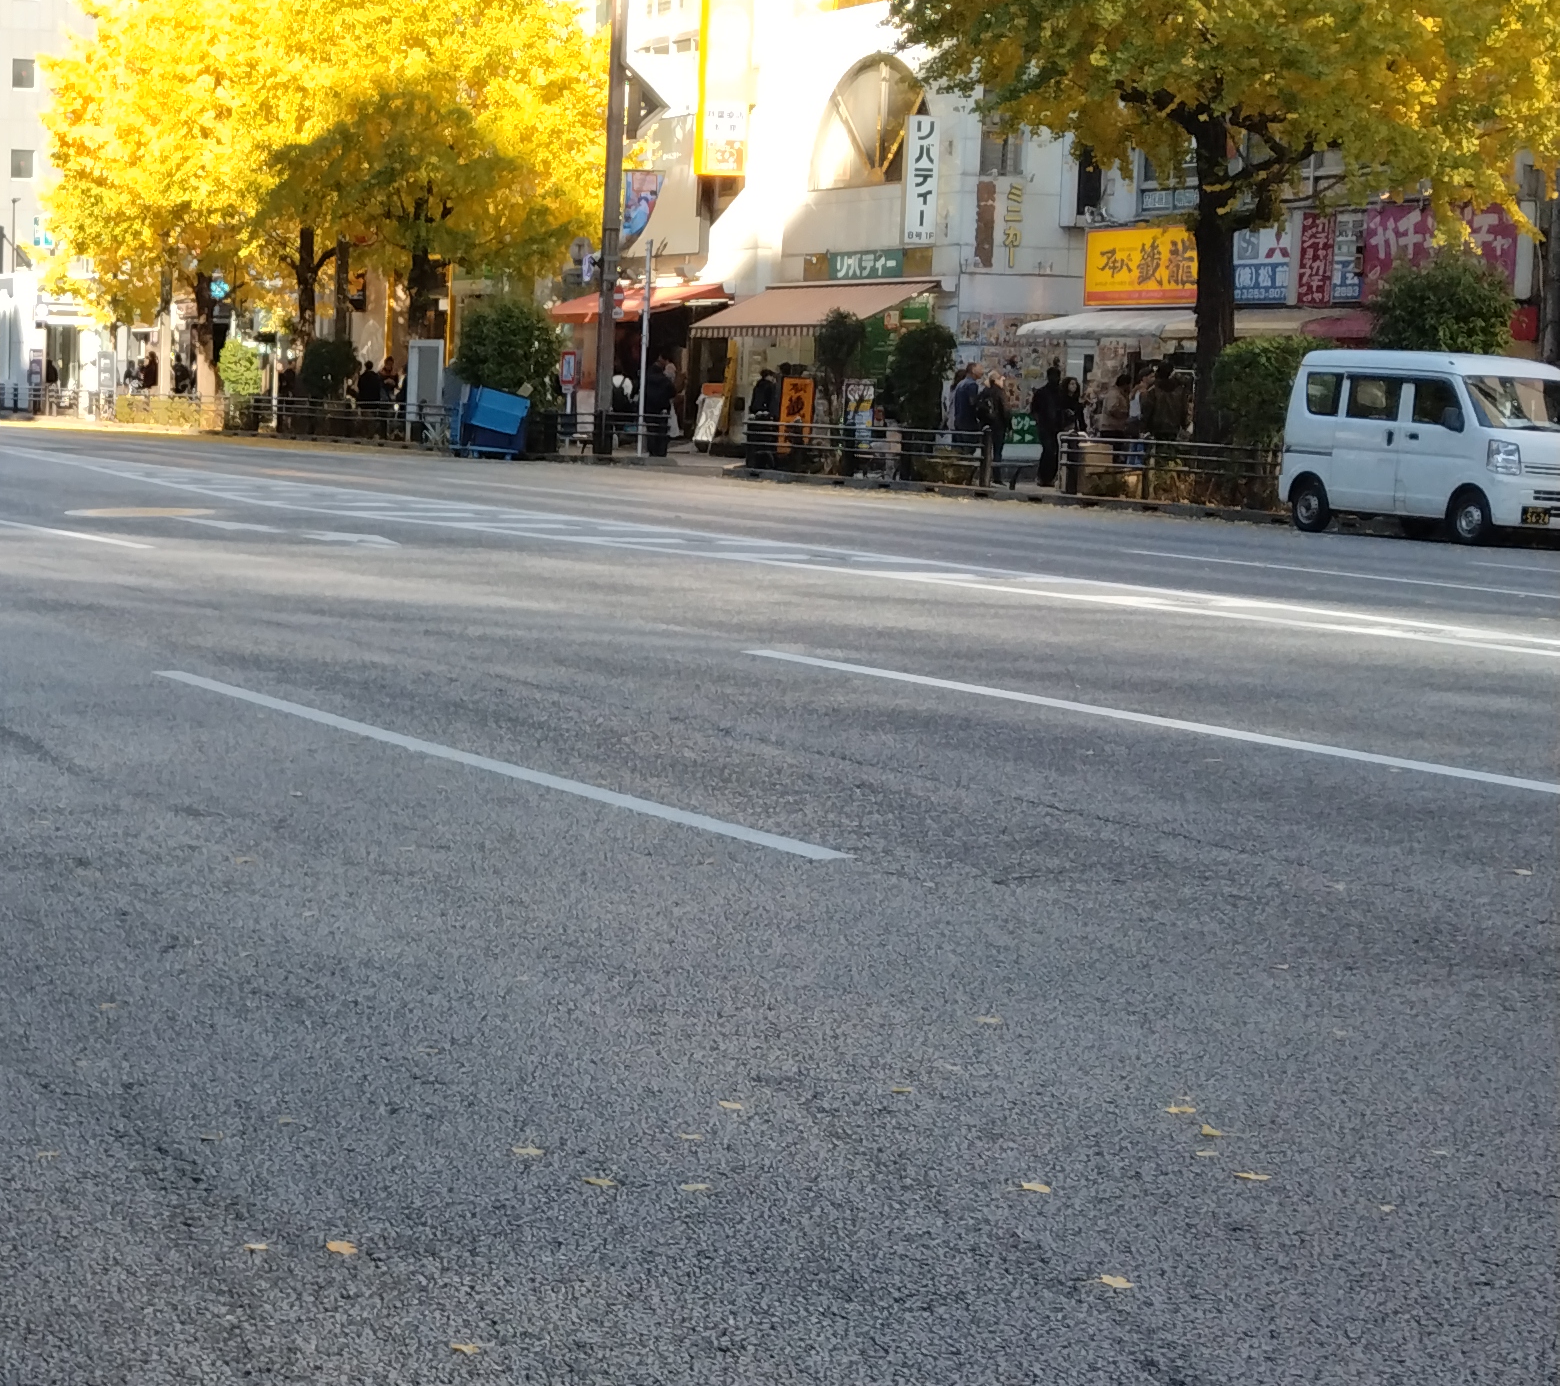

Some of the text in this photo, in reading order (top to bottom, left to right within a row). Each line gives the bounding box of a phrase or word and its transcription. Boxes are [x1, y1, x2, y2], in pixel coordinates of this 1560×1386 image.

[914, 120, 935, 227] リバティー
[836, 253, 897, 279] リバティー
[1003, 182, 1023, 269] ミニカー
